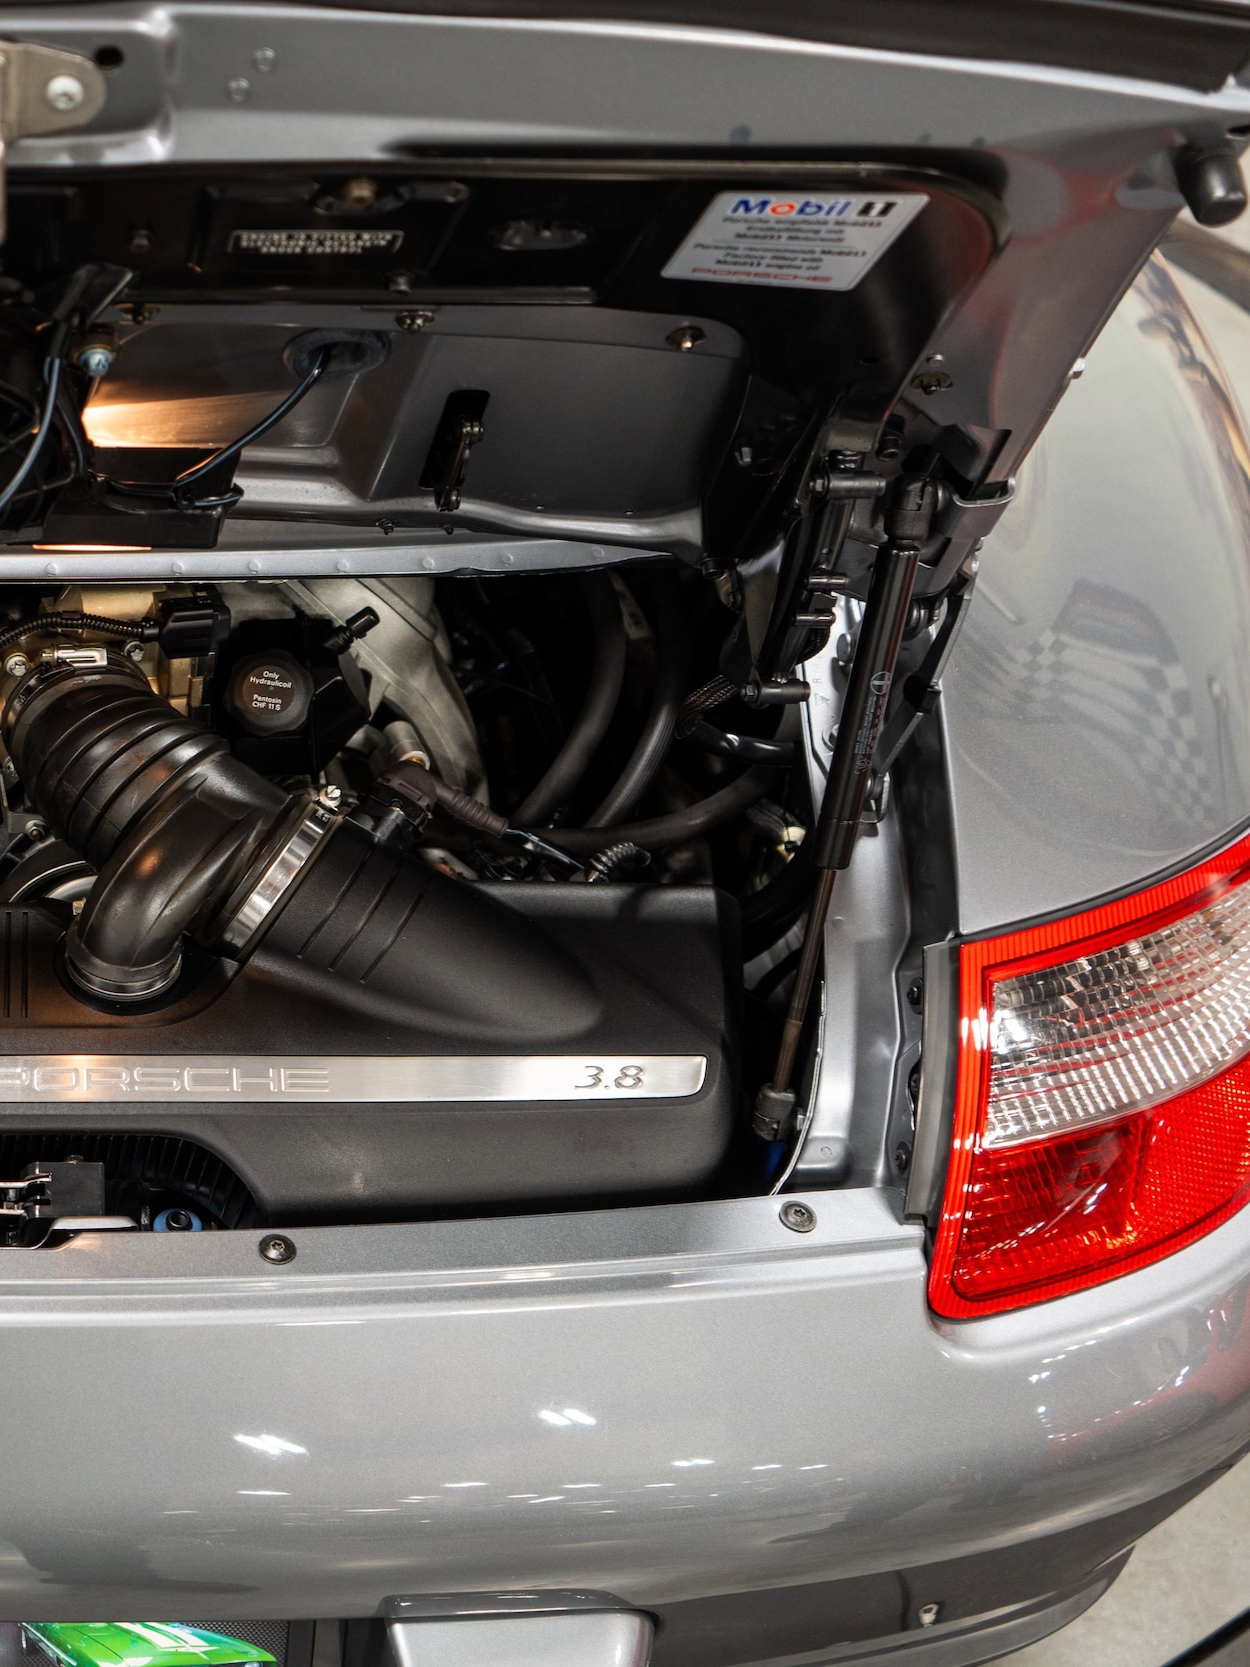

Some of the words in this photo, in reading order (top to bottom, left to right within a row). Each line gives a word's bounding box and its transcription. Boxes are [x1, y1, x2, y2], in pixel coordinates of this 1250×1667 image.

[731, 199, 852, 216] Mobil
[692, 267, 832, 282] PORSCHE
[263, 671, 280, 680] Only
[250, 676, 292, 688] Hydraulicoil
[252, 701, 266, 709] CHF
[253, 694, 282, 705] Pentosin
[574, 1064, 645, 1091] 3.8
